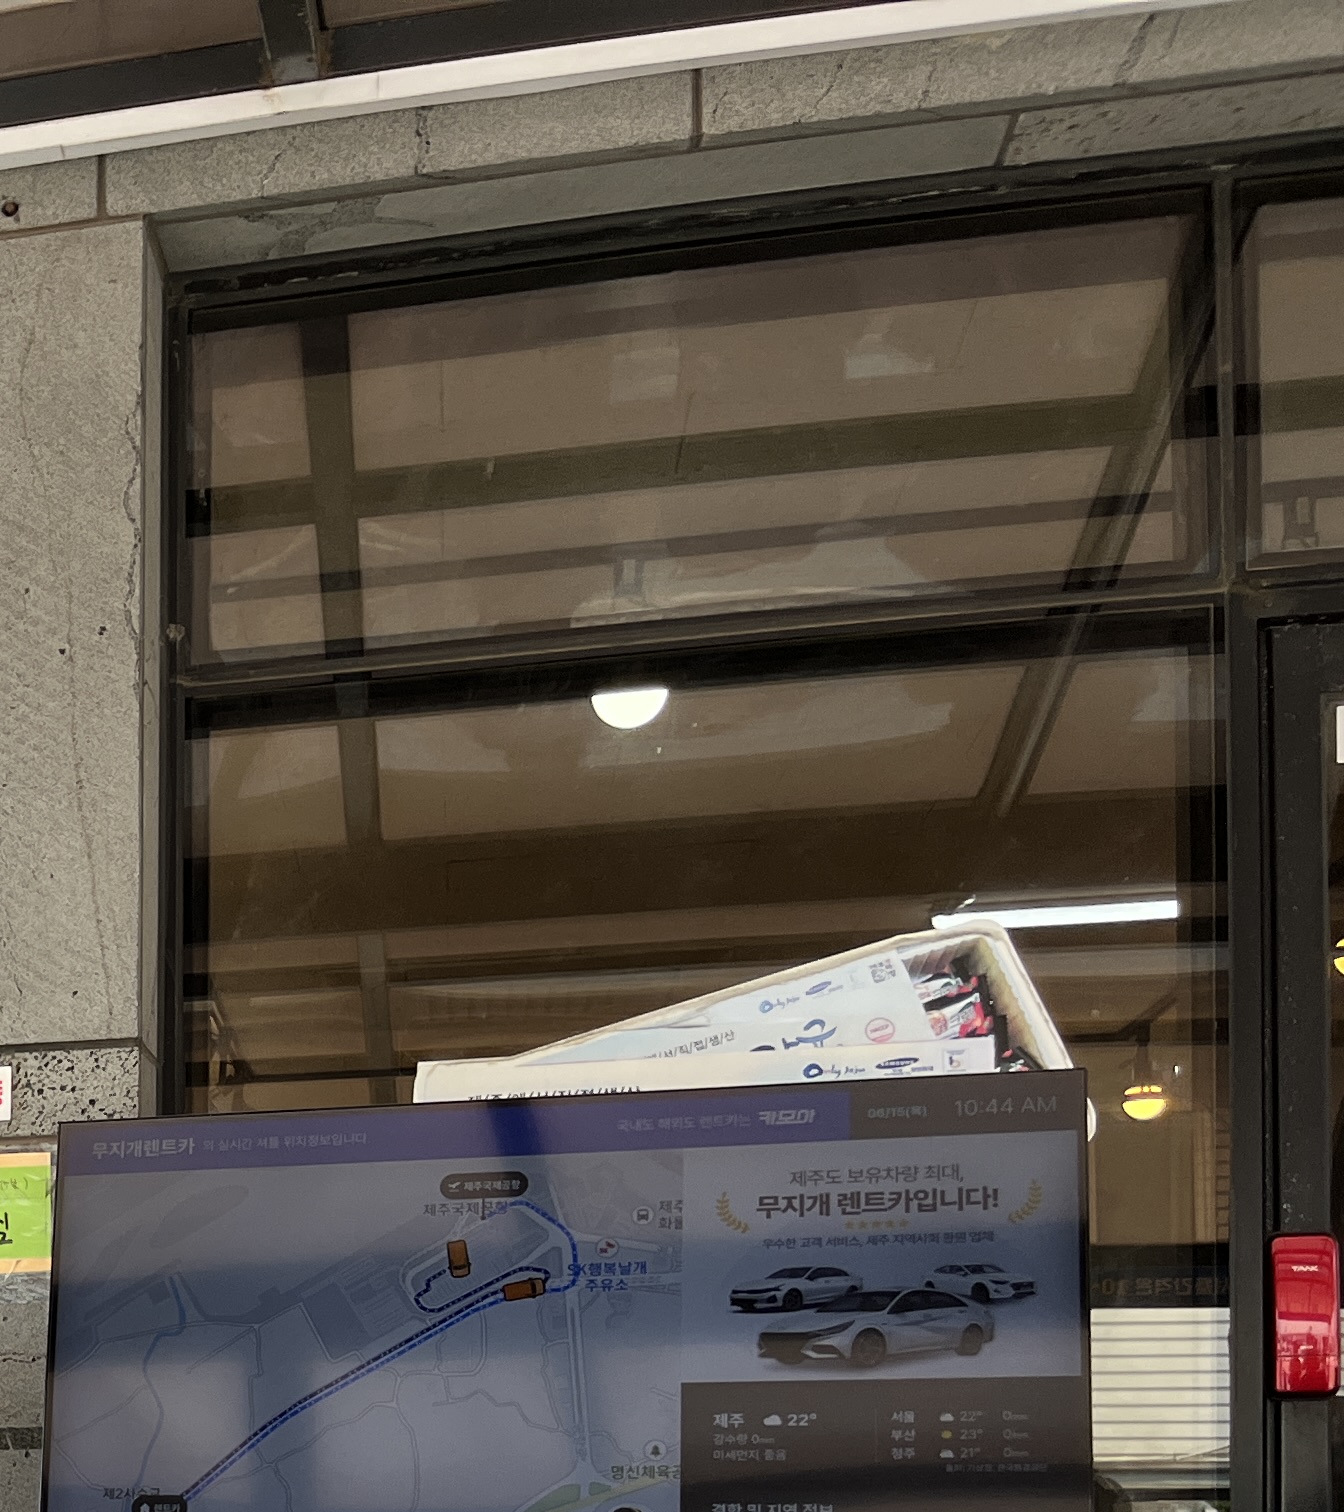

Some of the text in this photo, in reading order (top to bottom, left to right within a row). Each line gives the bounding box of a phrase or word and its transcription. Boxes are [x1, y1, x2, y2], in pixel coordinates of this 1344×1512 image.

[953, 1096, 1015, 1118] 10:44
[1020, 1095, 1058, 1114] AM
[757, 1108, 816, 1125] 카모아
[92, 1137, 195, 1160] 무지개렌트카
[217, 1137, 253, 1152] 실시간
[283, 1132, 369, 1150] 위치정보입니다
[789, 1167, 843, 1187] 제주도
[847, 1164, 920, 1185] 보유차량
[463, 1180, 522, 1192] 제주국제공항
[756, 1186, 1000, 1219] 무지개 렌트카입니다!
[567, 1261, 648, 1276] SK행복날개
[585, 1278, 629, 1292] 주유소
[713, 1412, 818, 1429] 제주 22°
[712, 1449, 761, 1462] 미세먼지
